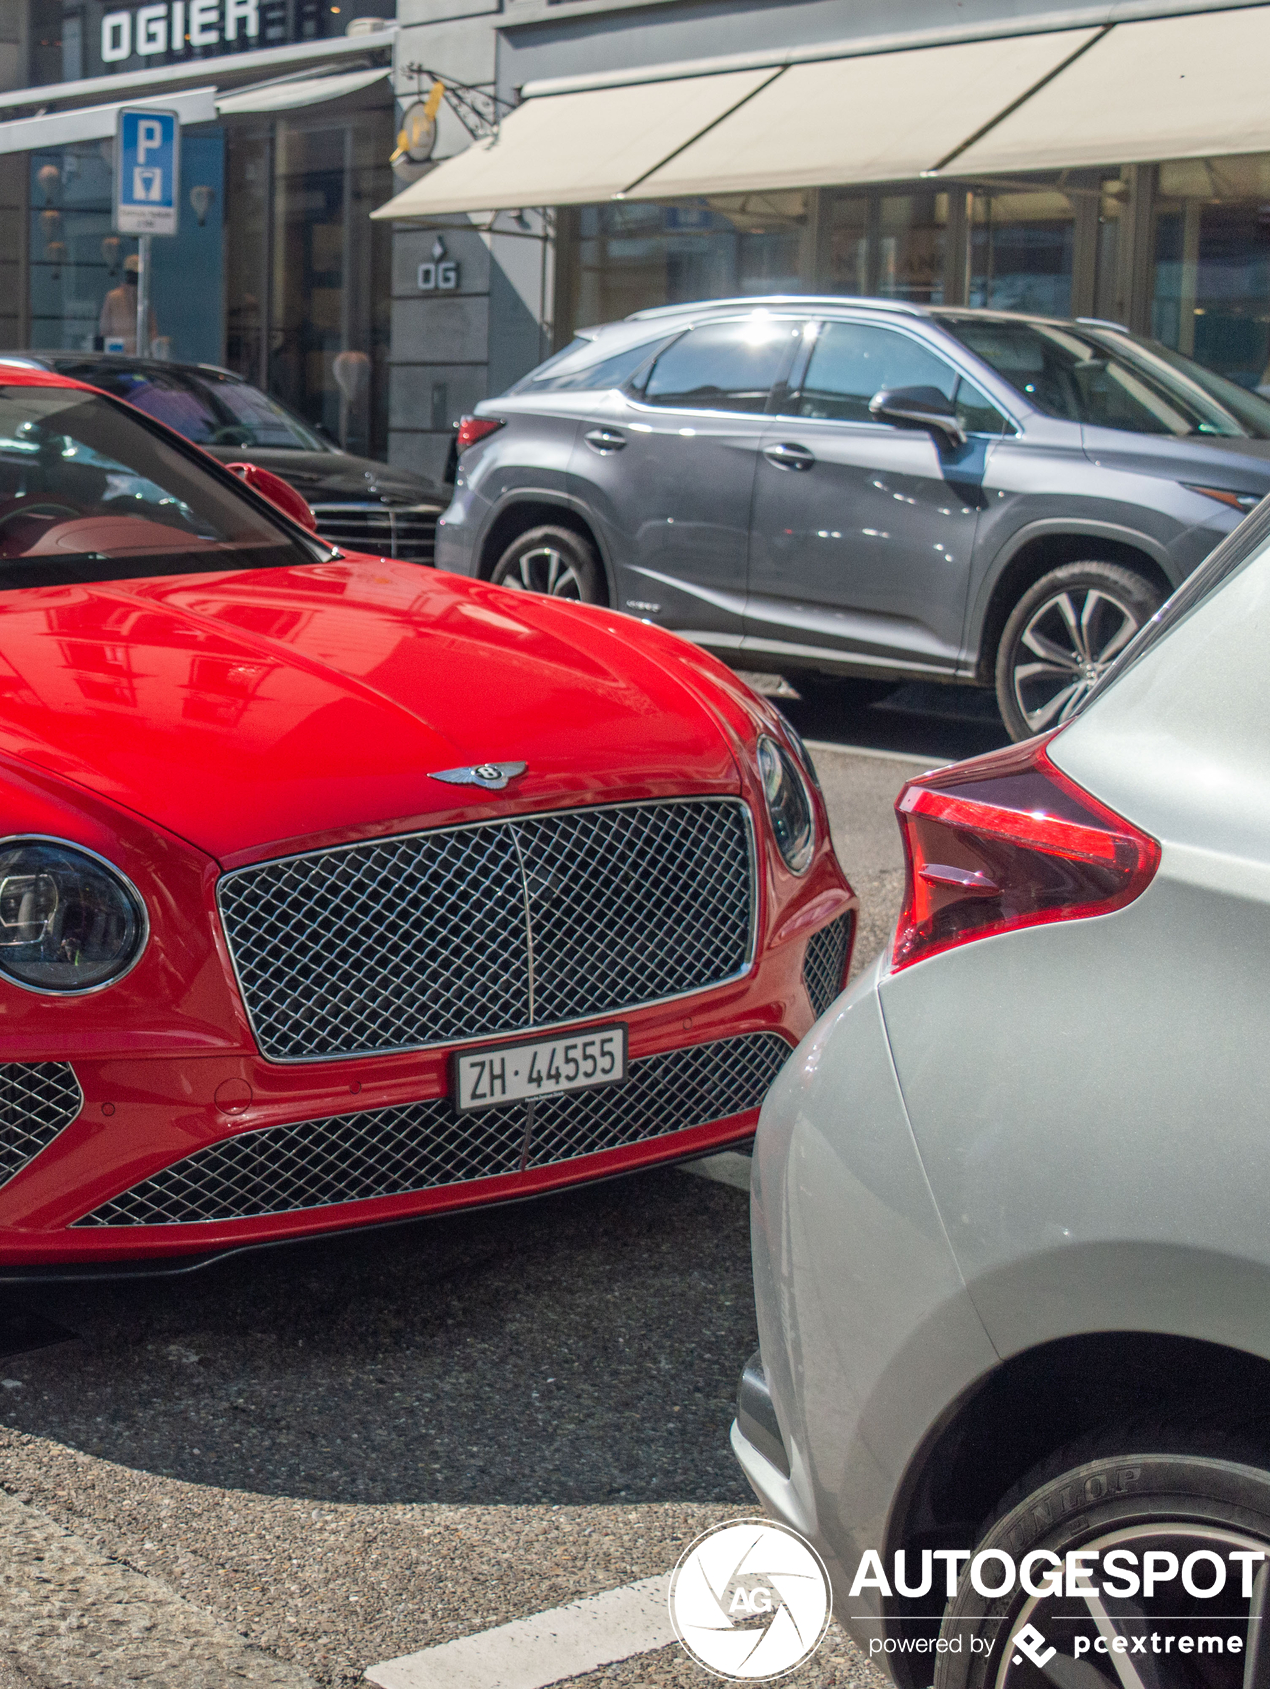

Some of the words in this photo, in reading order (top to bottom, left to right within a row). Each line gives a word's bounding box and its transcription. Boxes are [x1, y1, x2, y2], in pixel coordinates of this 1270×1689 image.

[101, 0, 259, 63] OGIER
[137, 119, 162, 165] P
[418, 262, 457, 290] OG
[469, 1057, 507, 1101] ZH
[527, 1036, 616, 1089] 44555
